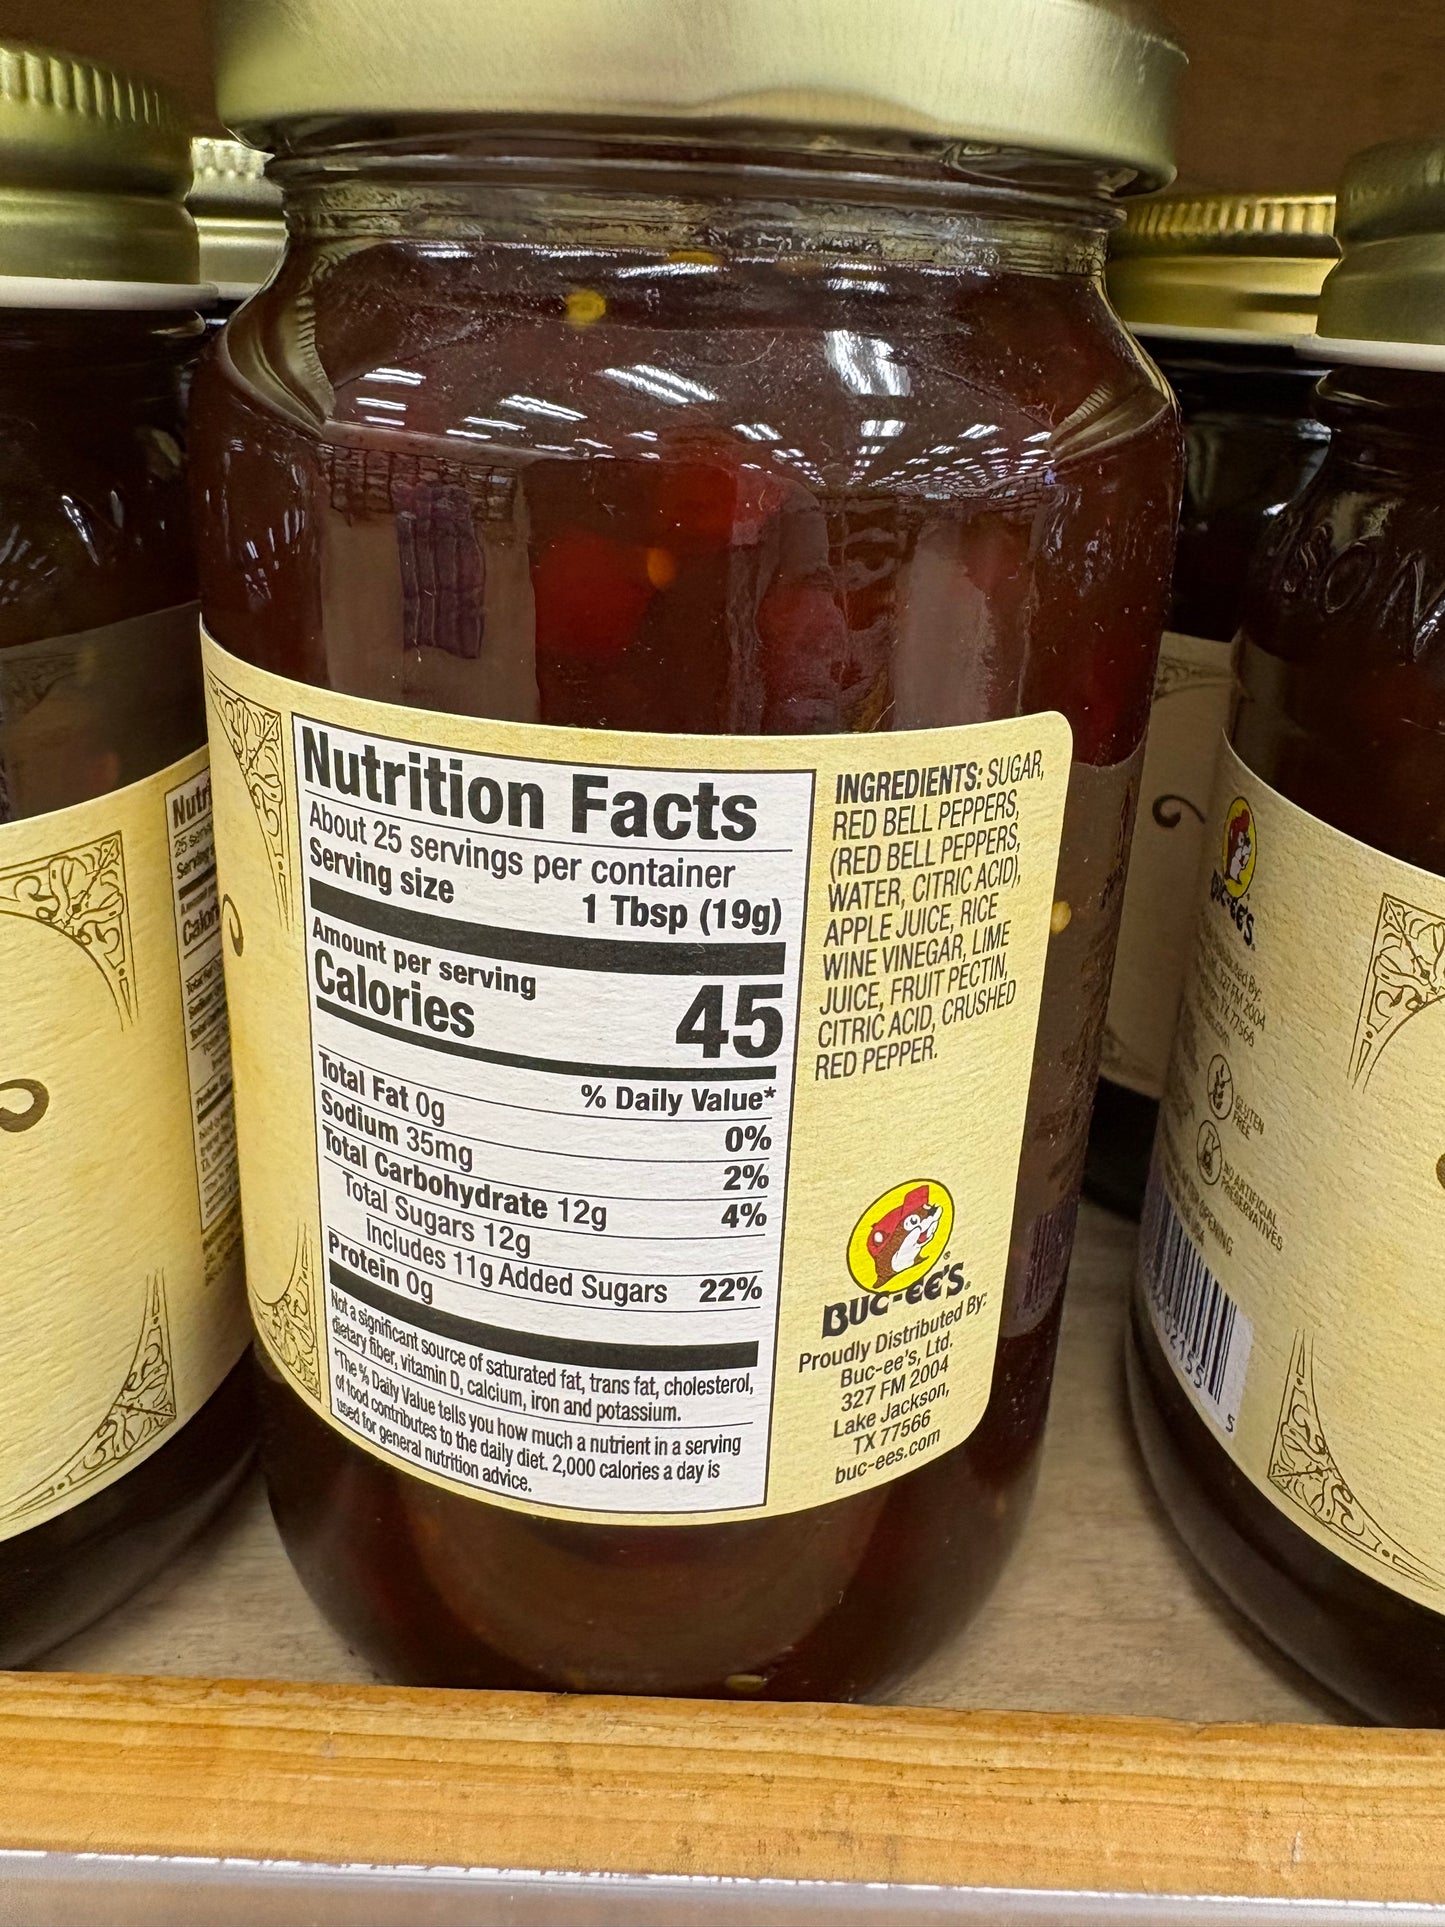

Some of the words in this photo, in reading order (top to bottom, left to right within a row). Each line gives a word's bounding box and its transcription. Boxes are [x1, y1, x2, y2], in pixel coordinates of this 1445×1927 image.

[302, 726, 544, 830] Nutrition
[572, 773, 758, 841] Facts
[836, 762, 983, 804] INGREDIENTS:
[987, 750, 1044, 788] SUGAR,
[310, 801, 367, 845] About
[374, 820, 402, 854] 25
[411, 830, 523, 881] servings
[534, 853, 582, 886] per
[591, 859, 736, 888] container
[833, 809, 877, 841] RED
[883, 804, 933, 836] BELL
[938, 789, 1020, 830] PEPPERS,
[310, 839, 392, 895] Serving
[401, 871, 454, 902] size
[583, 895, 596, 924] 1
[611, 895, 688, 934] Tbsp
[700, 898, 782, 936] (19g)
[828, 877, 906, 911] WATER,
[913, 865, 973, 902] CITRIC
[974, 854, 1021, 891] ACID),
[830, 846, 881, 884] (RED
[887, 838, 936, 871] BELL
[940, 822, 1021, 864] PEPPERS,
[823, 912, 893, 948] APPLE
[895, 903, 954, 939] JUICE,
[960, 892, 999, 926] RICE
[823, 948, 877, 981] WINE
[882, 933, 967, 973] VINEGAR,
[971, 920, 1012, 955] LIME
[313, 917, 387, 964] Amount
[394, 946, 431, 973] per
[439, 962, 536, 1000] serving
[819, 981, 884, 1015] JUICE,
[890, 968, 945, 1006] FRUIT
[947, 952, 1008, 994] PECTIN,
[315, 949, 475, 1038] Calories
[676, 983, 783, 1059] 45
[818, 1012, 885, 1049] CITRIC
[888, 1004, 936, 1038] ACID,
[942, 979, 1017, 1026] CRUSHED
[815, 1050, 857, 1081] RED
[862, 1034, 938, 1074] PEPPER.
[319, 1051, 365, 1096] Total
[373, 1075, 408, 1112] Fat
[416, 1091, 444, 1127] 0g
[725, 1125, 772, 1152] 0%
[581, 1084, 607, 1109] %
[616, 1086, 683, 1117] Daily
[1232, 1110, 1252, 1140] FREE
[1235, 1094, 1265, 1135] GLUTEN
[321, 1089, 398, 1145] Sodium
[406, 1126, 473, 1172] 35mg
[723, 1164, 769, 1190] 2%
[322, 1125, 367, 1169] Total
[375, 1151, 548, 1219] Carbohydrate
[558, 1198, 607, 1232] 12g
[721, 1202, 767, 1228] 4%
[342, 1171, 388, 1214] Total
[395, 1195, 475, 1242] Sugars
[484, 1224, 530, 1259] 12g
[328, 1231, 399, 1287] Protein
[406, 1272, 433, 1305] 0g
[366, 1218, 446, 1270] Includes
[453, 1253, 493, 1287] 11g
[499, 1262, 573, 1297] Added
[582, 1275, 667, 1307] Sugars
[700, 1276, 762, 1303] 22%
[331, 1289, 348, 1317] Not
[349, 1305, 356, 1321] a
[358, 1308, 419, 1351] significant
[421, 1338, 466, 1367] source
[469, 1353, 483, 1371] of
[486, 1359, 556, 1387] saturated
[560, 1369, 585, 1395] fat,
[589, 1373, 630, 1395] trans
[634, 1376, 659, 1400] fat,
[664, 1373, 753, 1397] cholesterol,
[798, 1338, 870, 1373] Proudly
[875, 1305, 964, 1354] Distributed
[966, 1293, 988, 1319] By:
[840, 1348, 921, 1388] Buc-ee's,
[925, 1331, 954, 1360] Ltd.
[333, 1316, 367, 1354] dietary
[369, 1336, 398, 1370] fiber,
[400, 1354, 447, 1386] vitamin
[450, 1369, 464, 1395] D,
[467, 1378, 527, 1411] calcium,
[531, 1390, 559, 1413] iron
[564, 1398, 592, 1418] and
[596, 1402, 682, 1423] potassium.
[840, 1387, 876, 1413] 327
[880, 1374, 905, 1400] FM
[909, 1354, 950, 1389] 2004
[335, 1373, 346, 1390] of
[346, 1379, 369, 1408] food
[371, 1396, 437, 1441] contributes
[440, 1426, 451, 1446] to
[455, 1431, 477, 1454] the
[480, 1438, 514, 1467] daily
[516, 1448, 549, 1472] diet.
[552, 1454, 595, 1478] 2,000
[600, 1459, 660, 1481] calories
[663, 1465, 673, 1480] a
[676, 1461, 705, 1484] day
[707, 1459, 721, 1479] is
[336, 1398, 360, 1425] used
[362, 1410, 376, 1435] for
[379, 1425, 422, 1458] general
[424, 1446, 479, 1480] nutrition
[482, 1465, 533, 1493] advice.
[358, 1363, 369, 1385] %
[372, 1370, 399, 1398] Daily
[401, 1384, 436, 1416] Value
[438, 1400, 466, 1427] tells
[469, 1412, 494, 1434] you
[497, 1417, 528, 1440] how
[532, 1428, 572, 1450] much
[577, 1436, 586, 1452] a
[590, 1435, 651, 1456] nutrient
[654, 1436, 668, 1456] in
[672, 1440, 682, 1456] a
[685, 1434, 742, 1456] serving
[833, 1412, 876, 1438] Lake
[880, 1388, 950, 1423] Jackson,
[853, 1434, 876, 1455] TX
[880, 1409, 932, 1445] 77566
[834, 1428, 942, 1485] buc-ees.com
